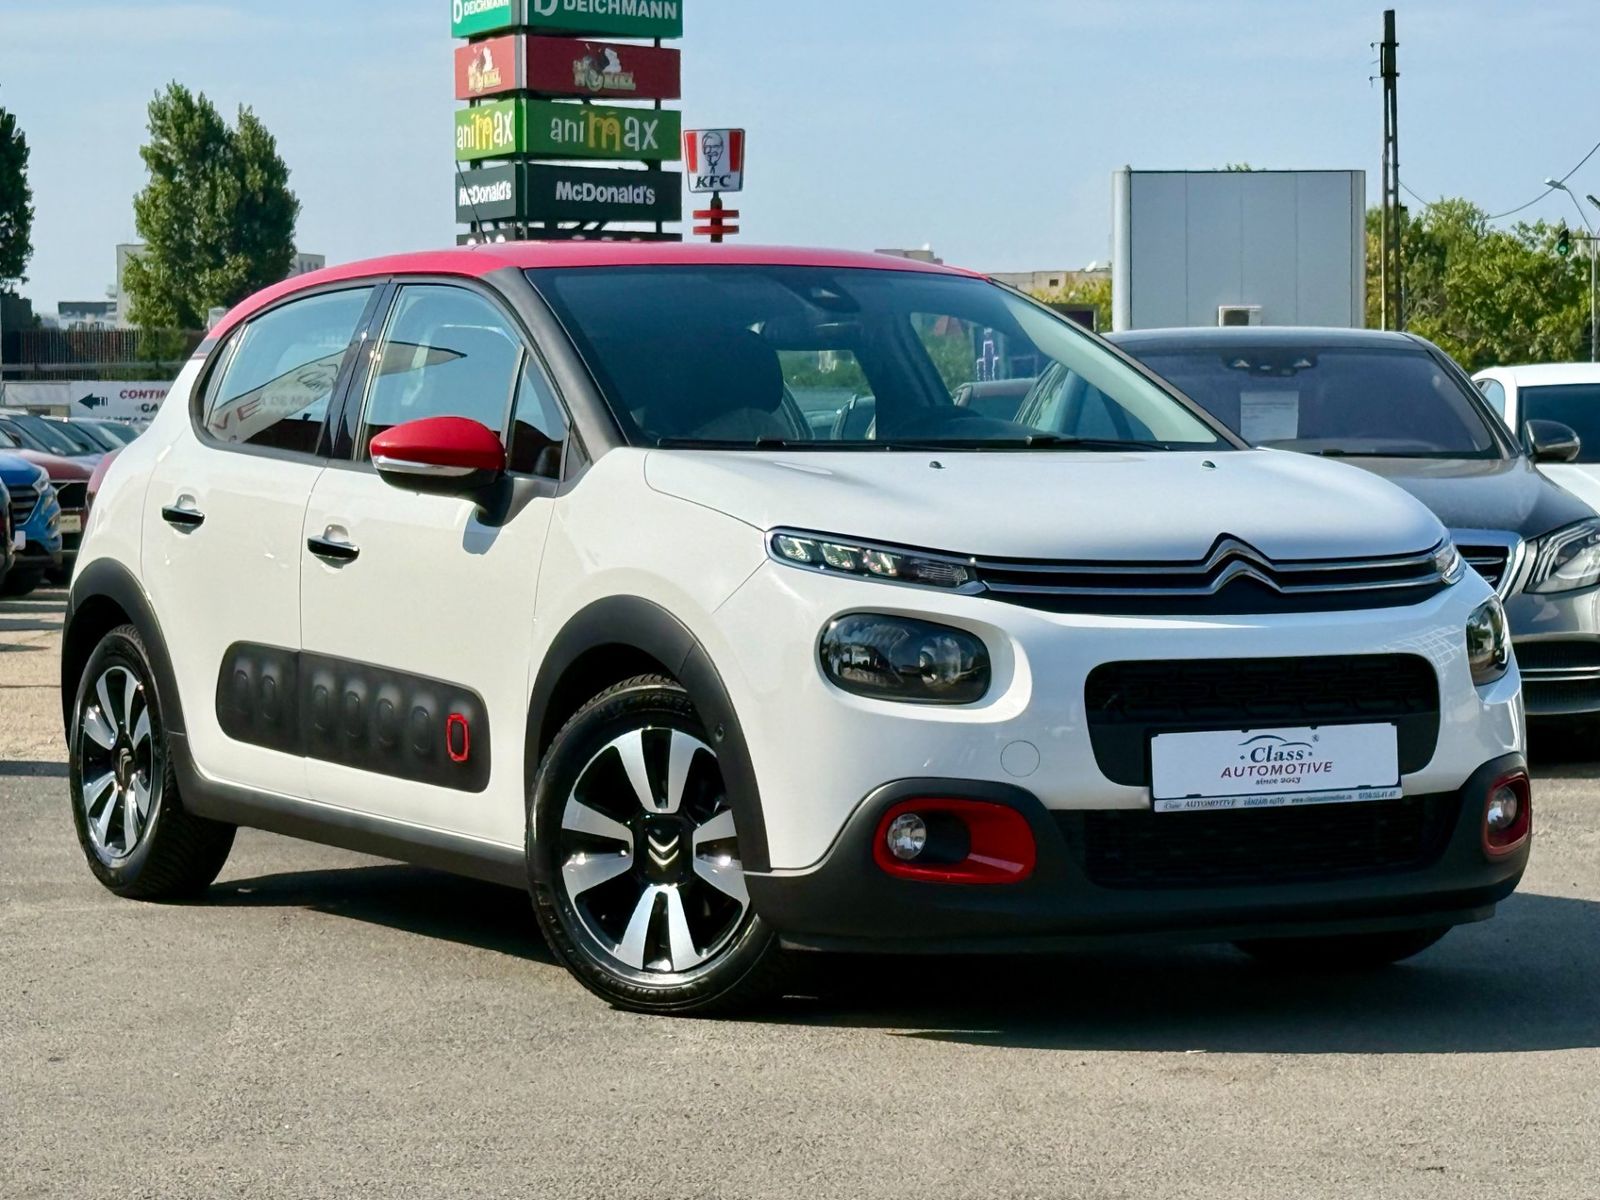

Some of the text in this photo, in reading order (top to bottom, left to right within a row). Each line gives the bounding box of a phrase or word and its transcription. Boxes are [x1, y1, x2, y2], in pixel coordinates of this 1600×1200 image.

[563, 0, 677, 20] DEICHMANN
[457, 109, 513, 150] animax
[550, 110, 659, 152] animax
[695, 174, 732, 189] KFC
[459, 180, 512, 206] McDonald's
[555, 181, 656, 205] McDonald's
[1250, 745, 1304, 763] Class
[1220, 761, 1334, 779] AUTOMOTIVE
[1184, 799, 1237, 809] AUTOMOTIVE
